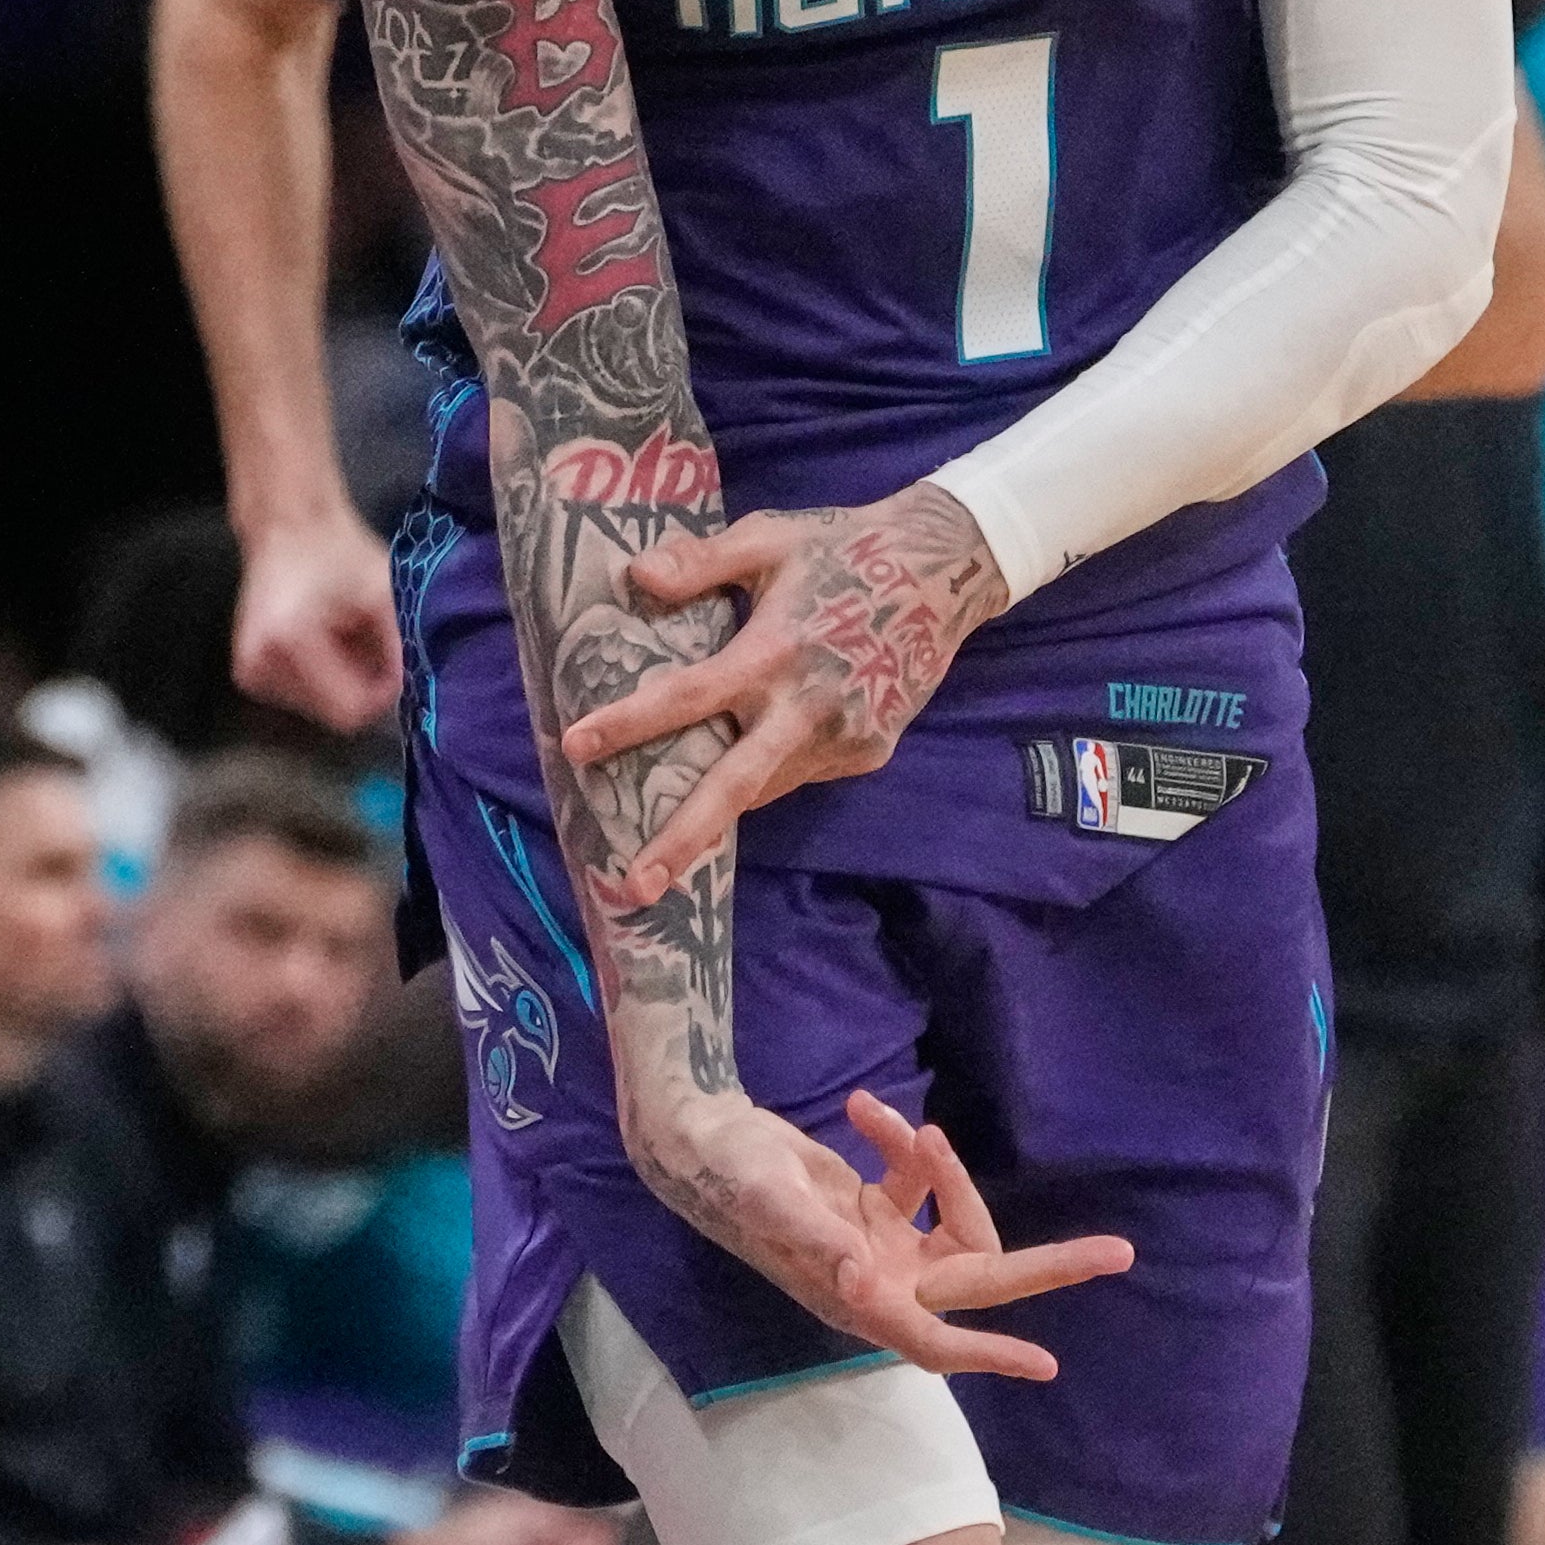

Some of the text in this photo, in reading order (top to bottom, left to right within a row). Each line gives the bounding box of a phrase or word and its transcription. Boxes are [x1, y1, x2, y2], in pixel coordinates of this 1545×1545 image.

[930, 32, 1056, 365] 1
[1107, 682, 1247, 729] CHARLOTTE
[1126, 767, 1146, 784] 44
